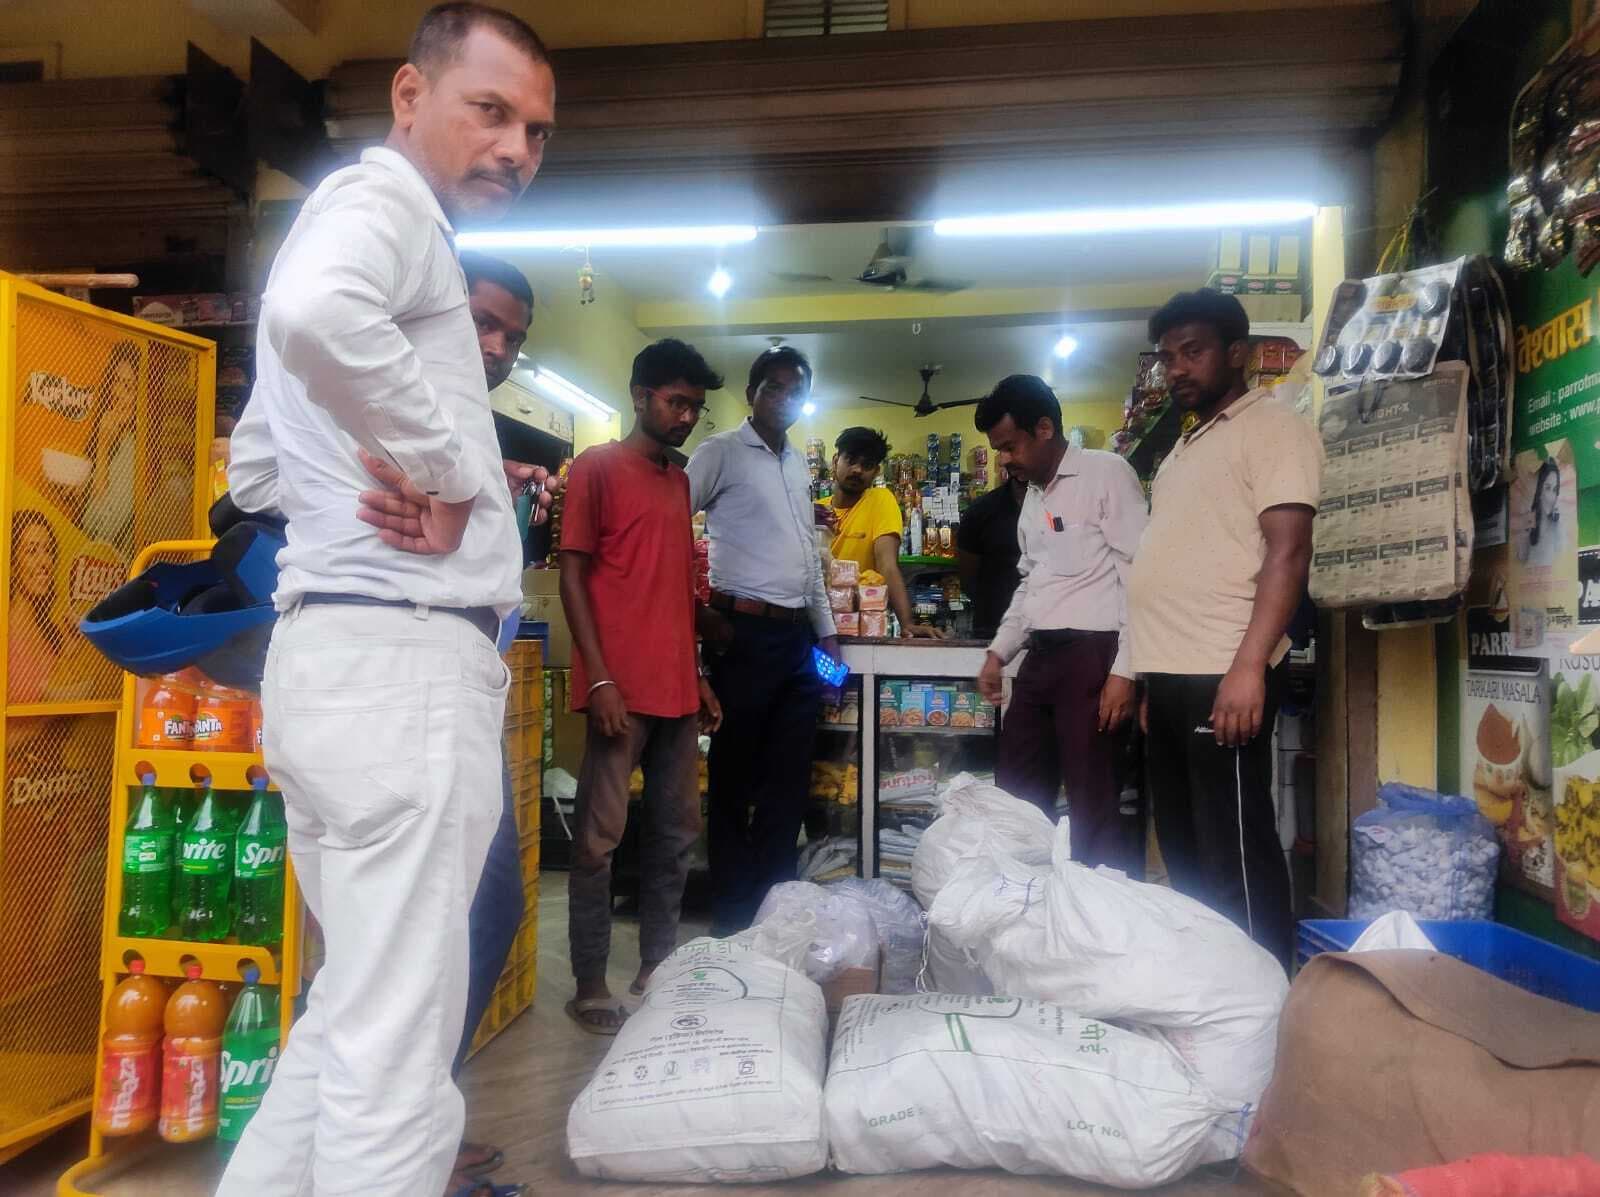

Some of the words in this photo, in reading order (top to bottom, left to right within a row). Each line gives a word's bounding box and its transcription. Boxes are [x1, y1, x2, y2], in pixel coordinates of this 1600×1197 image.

[1528, 390, 1551, 414] Email
[1528, 412, 1561, 437] website
[220, 1047, 279, 1093] Spri
[868, 1107, 914, 1128] GRADE
[1065, 1119, 1096, 1135] LOT
